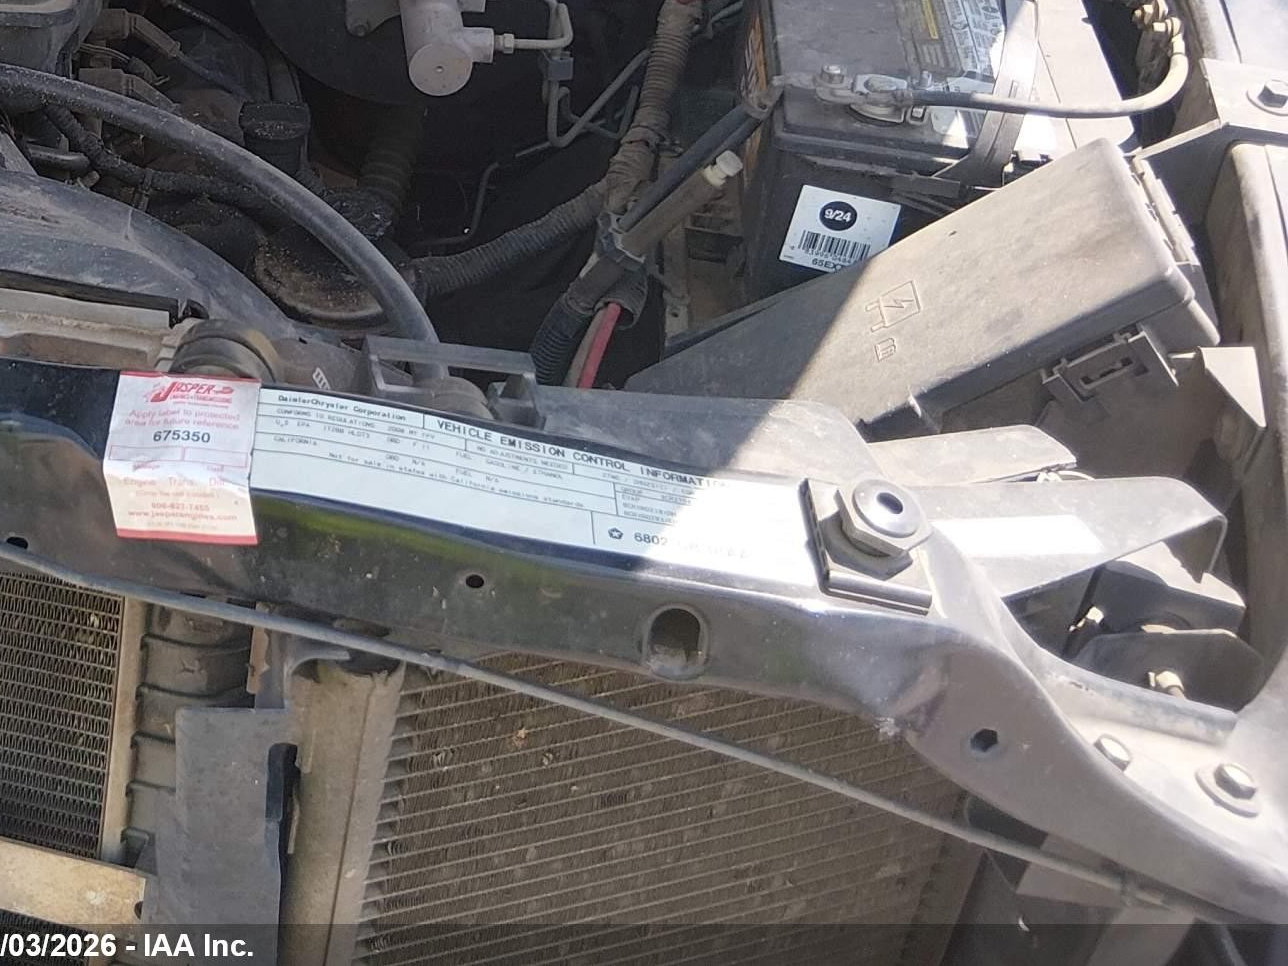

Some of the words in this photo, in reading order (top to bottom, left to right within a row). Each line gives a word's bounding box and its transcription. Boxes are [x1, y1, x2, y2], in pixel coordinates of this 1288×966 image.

[824, 208, 852, 223] 9/24
[150, 381, 216, 403] JASPER
[129, 409, 156, 420] Apply
[158, 409, 180, 417] label
[194, 410, 240, 421] protected
[278, 395, 349, 411] DaimlerChrysler
[352, 405, 407, 422] Corporation
[124, 418, 146, 427] area
[149, 417, 161, 426] for
[163, 416, 190, 426] future
[193, 418, 240, 430] reference
[153, 429, 212, 443] 675350
[437, 419, 493, 442] VEHICLE
[500, 435, 566, 458] EMISSION
[572, 451, 631, 472] CONTROL
[364, 458, 381, 467] sale
[398, 464, 425, 476] states
[450, 475, 496, 492] California
[498, 487, 539, 500] emissions
